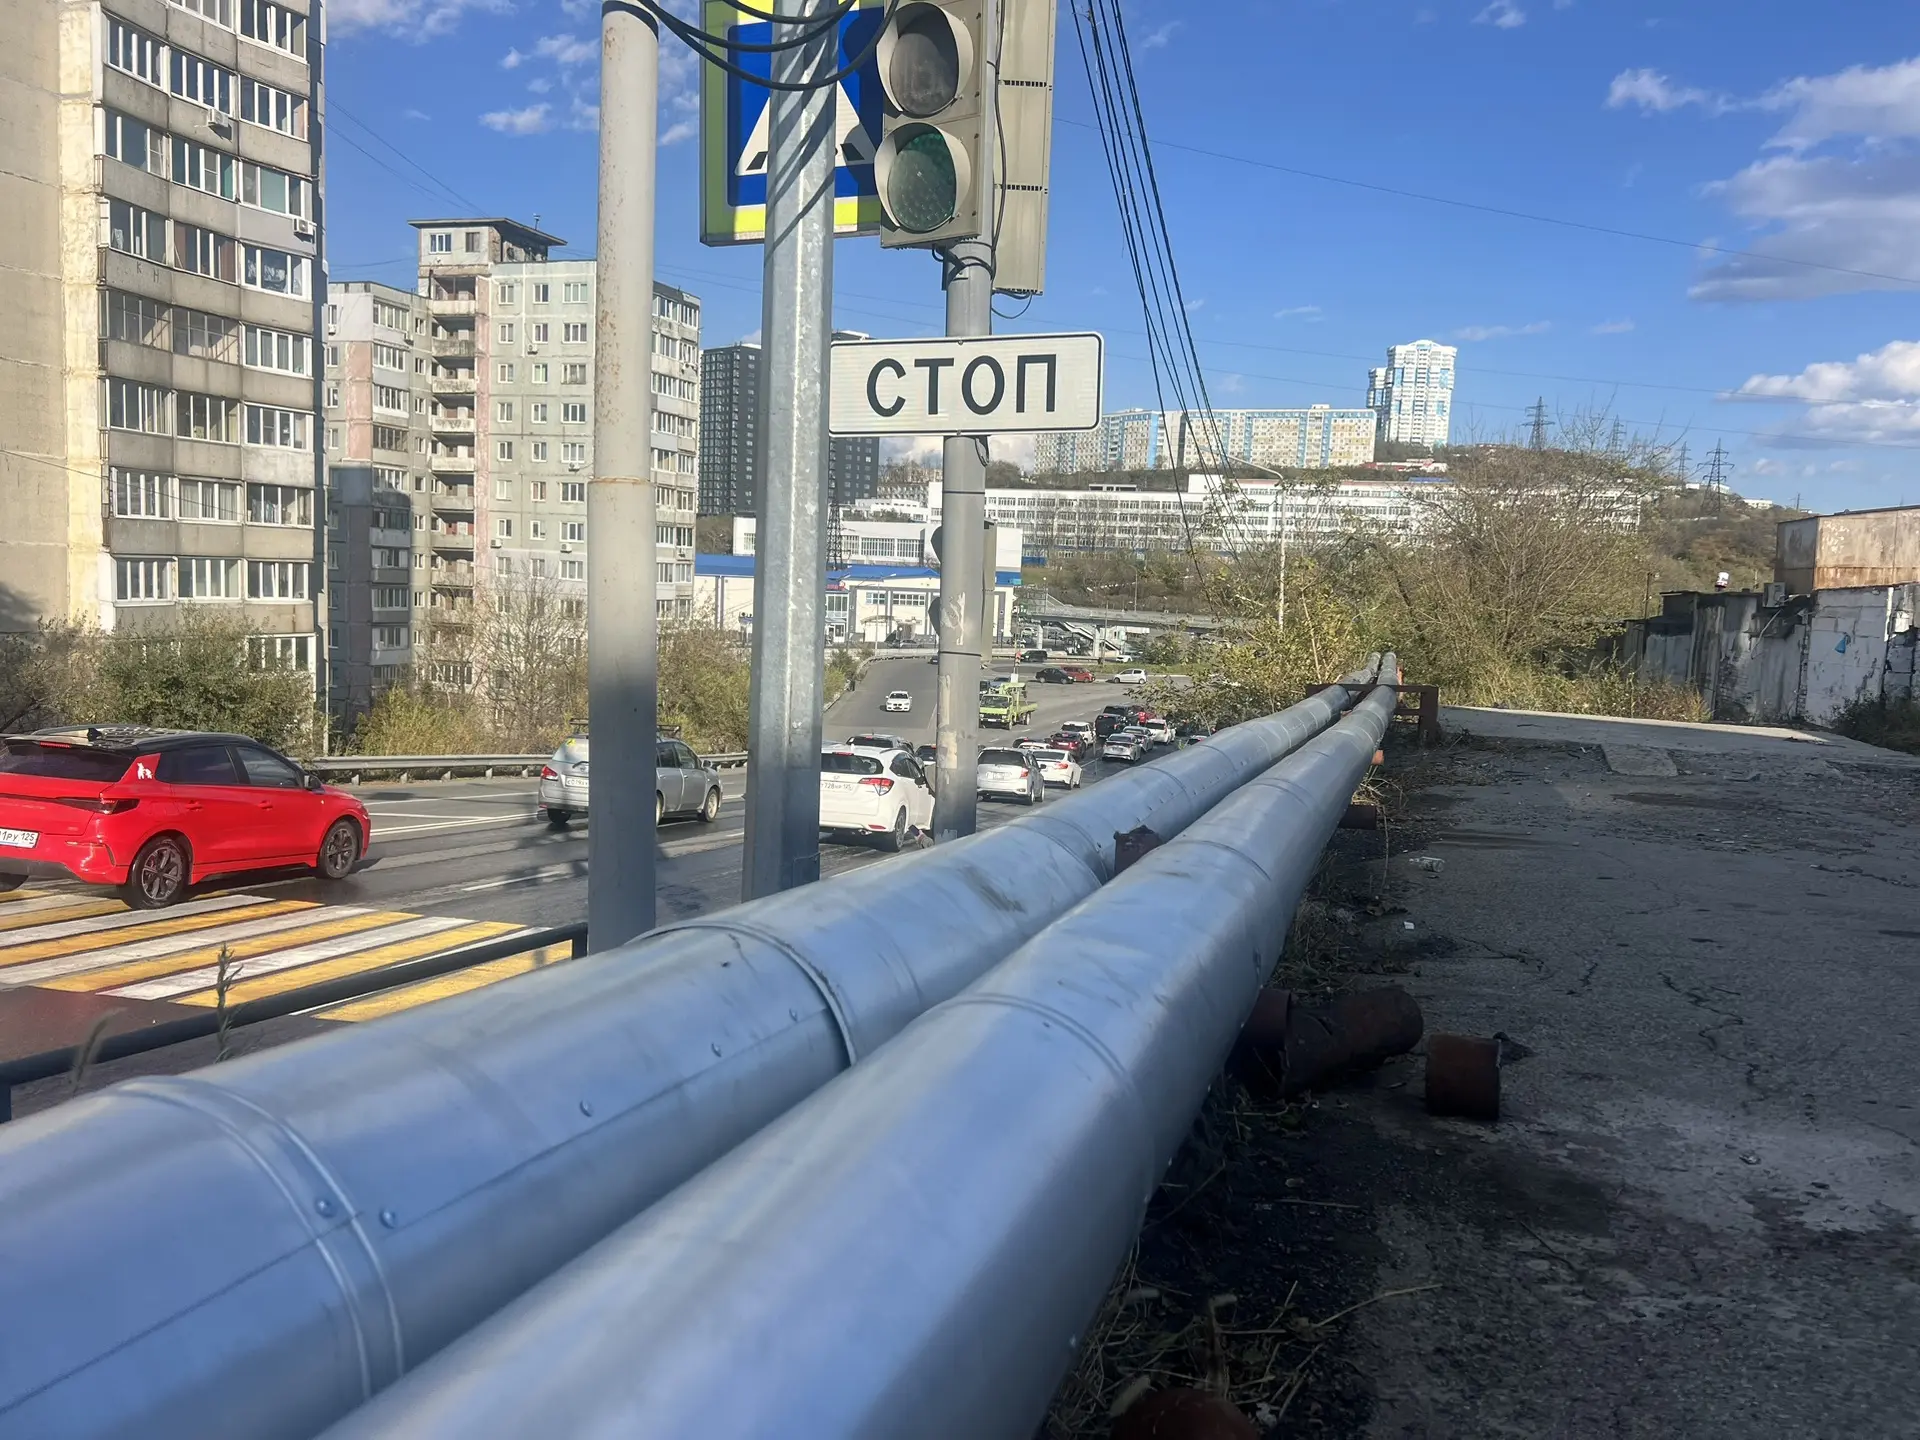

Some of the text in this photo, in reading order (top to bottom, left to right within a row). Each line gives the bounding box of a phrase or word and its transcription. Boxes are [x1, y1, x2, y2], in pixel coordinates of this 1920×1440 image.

[866, 354, 1057, 417] СТОП
[0, 830, 35, 842] 1РУ 125
